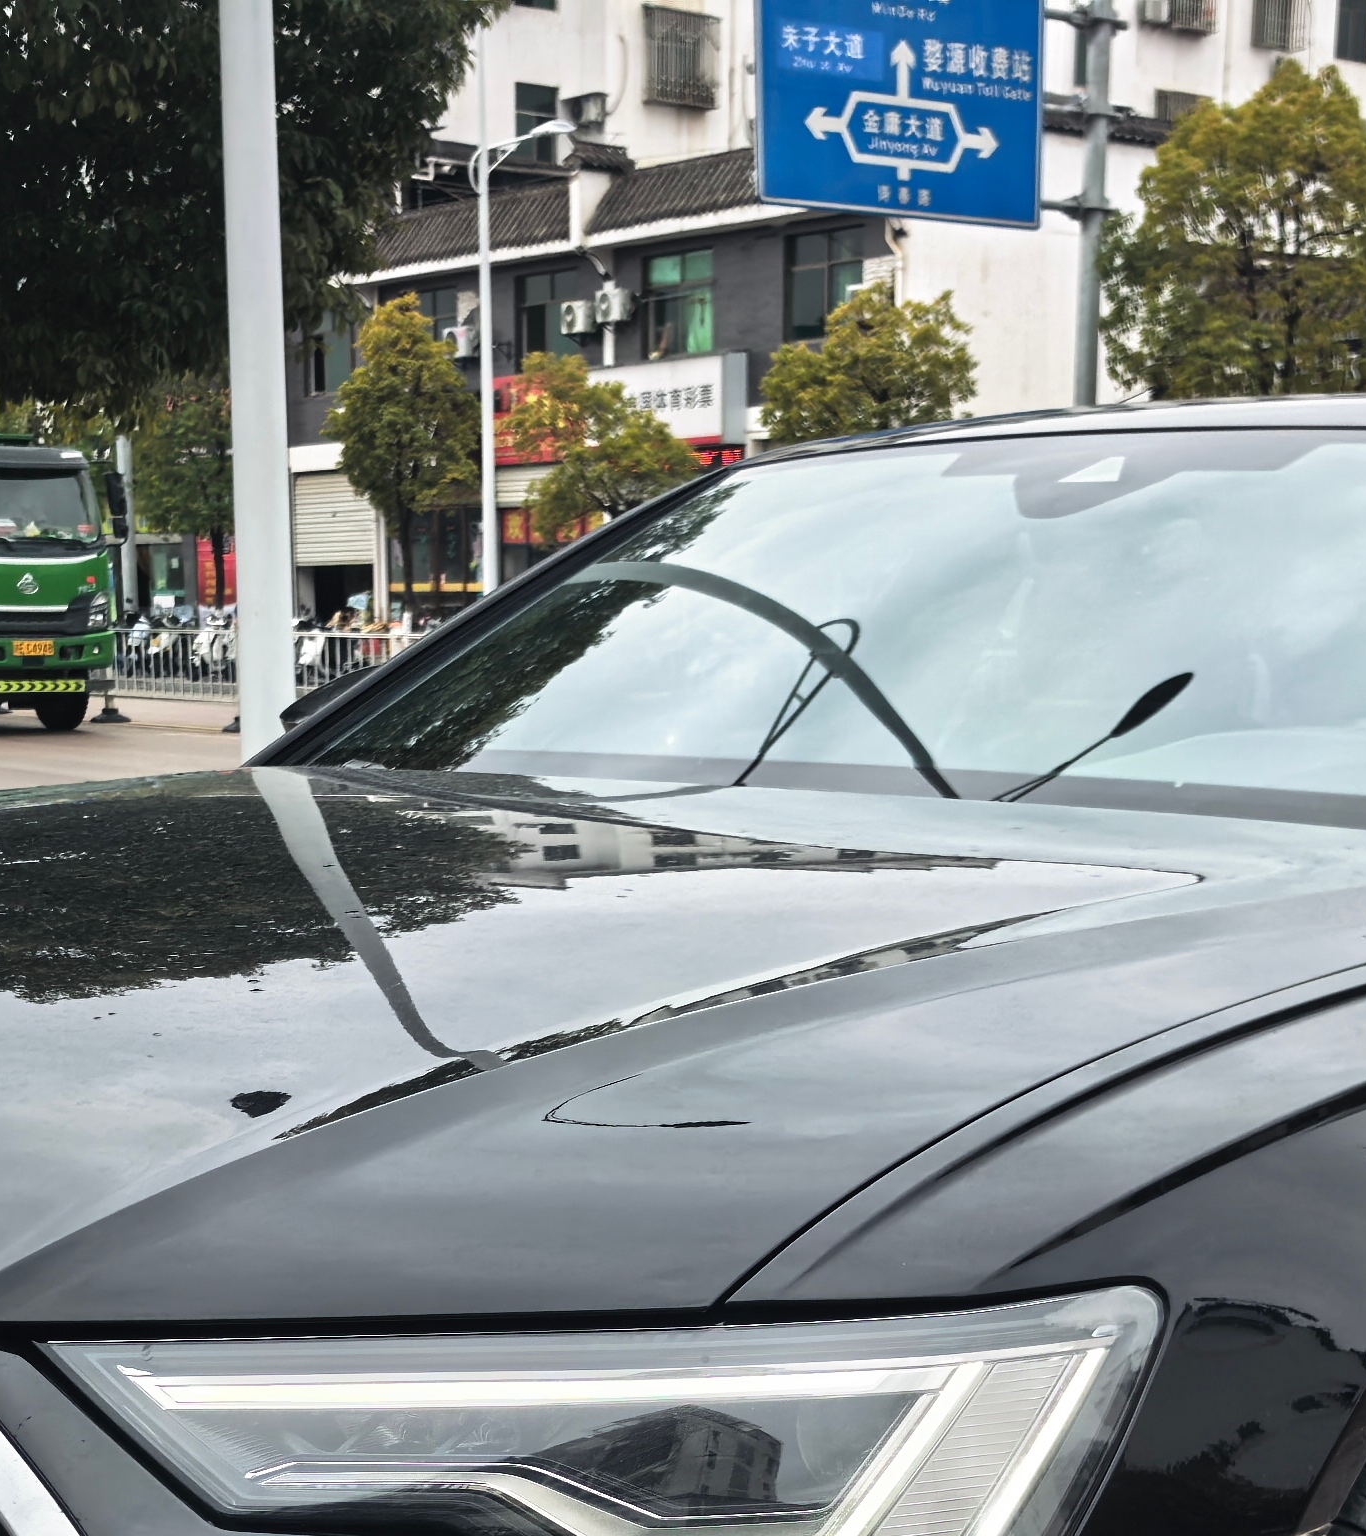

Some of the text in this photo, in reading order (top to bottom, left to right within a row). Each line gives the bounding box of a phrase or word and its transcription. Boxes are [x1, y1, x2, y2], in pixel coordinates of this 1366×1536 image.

[781, 24, 865, 59] 朱子大道
[922, 39, 1033, 83] 婺源收费站
[921, 77, 1033, 101] Wuyuan Toll Gate
[862, 110, 944, 141] 金庸大道
[867, 136, 939, 158] Jinyong Av
